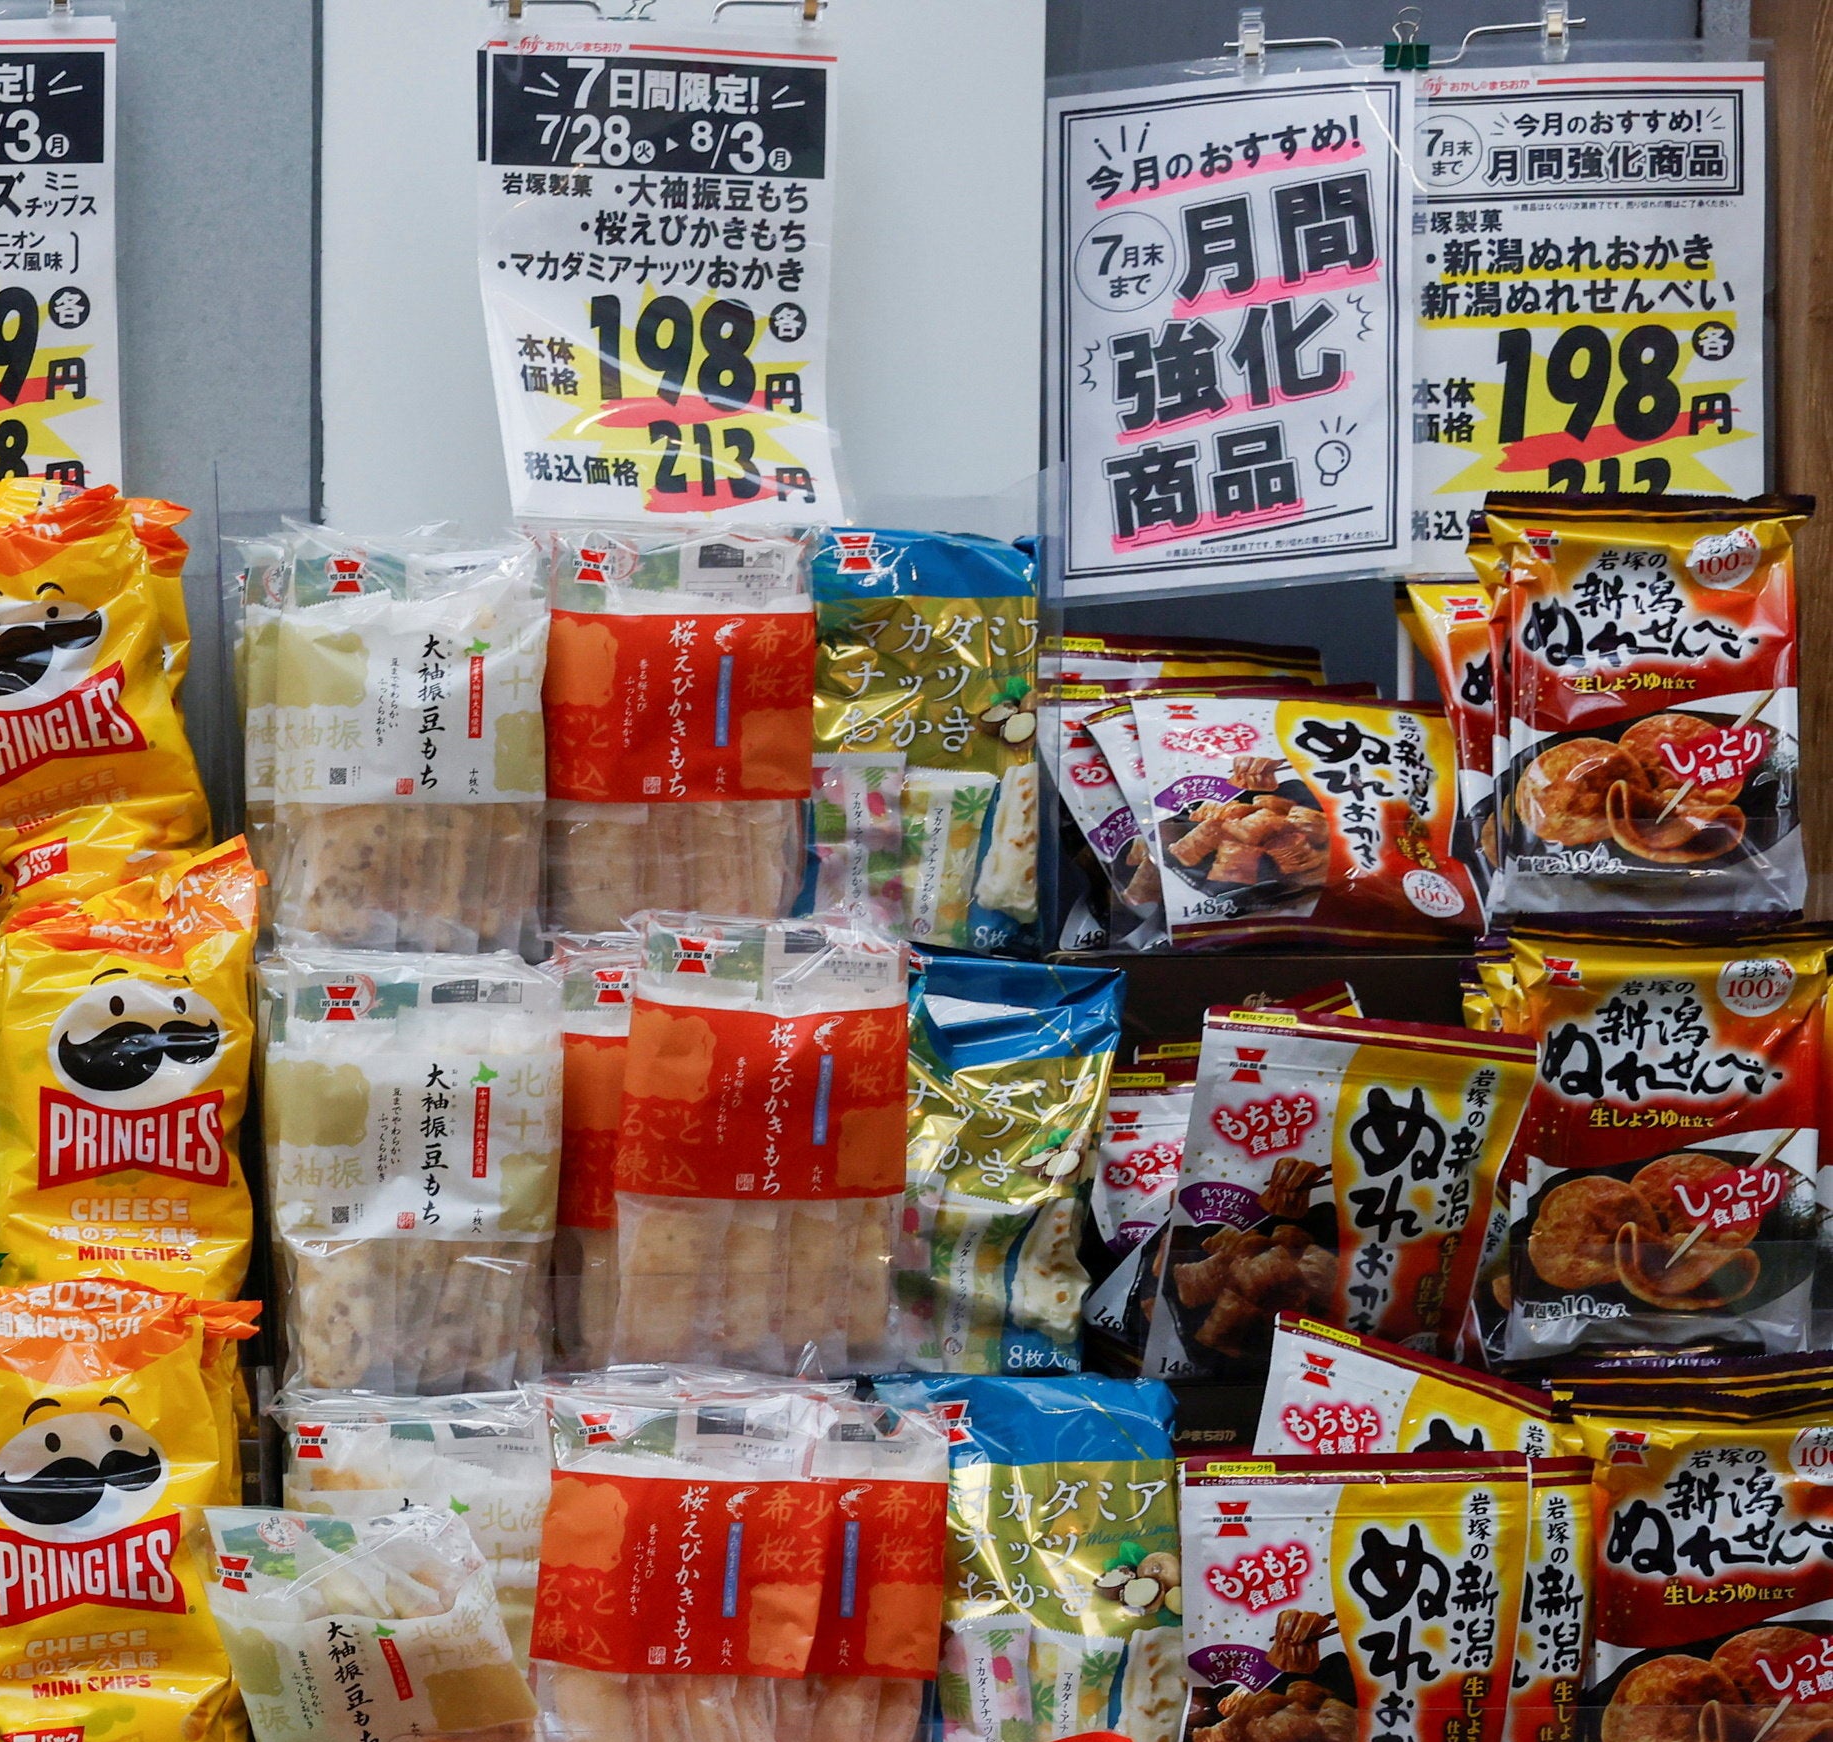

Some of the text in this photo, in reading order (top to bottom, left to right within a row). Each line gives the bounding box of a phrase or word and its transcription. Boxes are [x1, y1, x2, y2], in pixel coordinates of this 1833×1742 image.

[566, 58, 760, 114] 7日間限定!
[1515, 109, 1703, 136] 今月のおすすめ!
[1087, 116, 1360, 201] 今月のおすすめ!
[1485, 144, 1725, 186] 月間強化商品
[45, 172, 79, 191] ミニ
[502, 173, 593, 197] 岩塚製菓
[25, 195, 97, 217] チップス
[1089, 233, 1165, 275] 7月末
[1177, 174, 1375, 302] 月間
[1110, 272, 1151, 298] まで
[1112, 299, 1344, 436] 強化
[524, 451, 639, 487] 税込価格
[1104, 425, 1301, 541] 商品
[418, 634, 446, 791] 大袖振豆もち
[667, 620, 699, 799] 桜えびかきもち
[1660, 729, 1766, 768] しっとり
[47, 1100, 222, 1177] PRINGLES
[1209, 1546, 1308, 1598] もちもち
[31, 1678, 84, 1698] MINI
